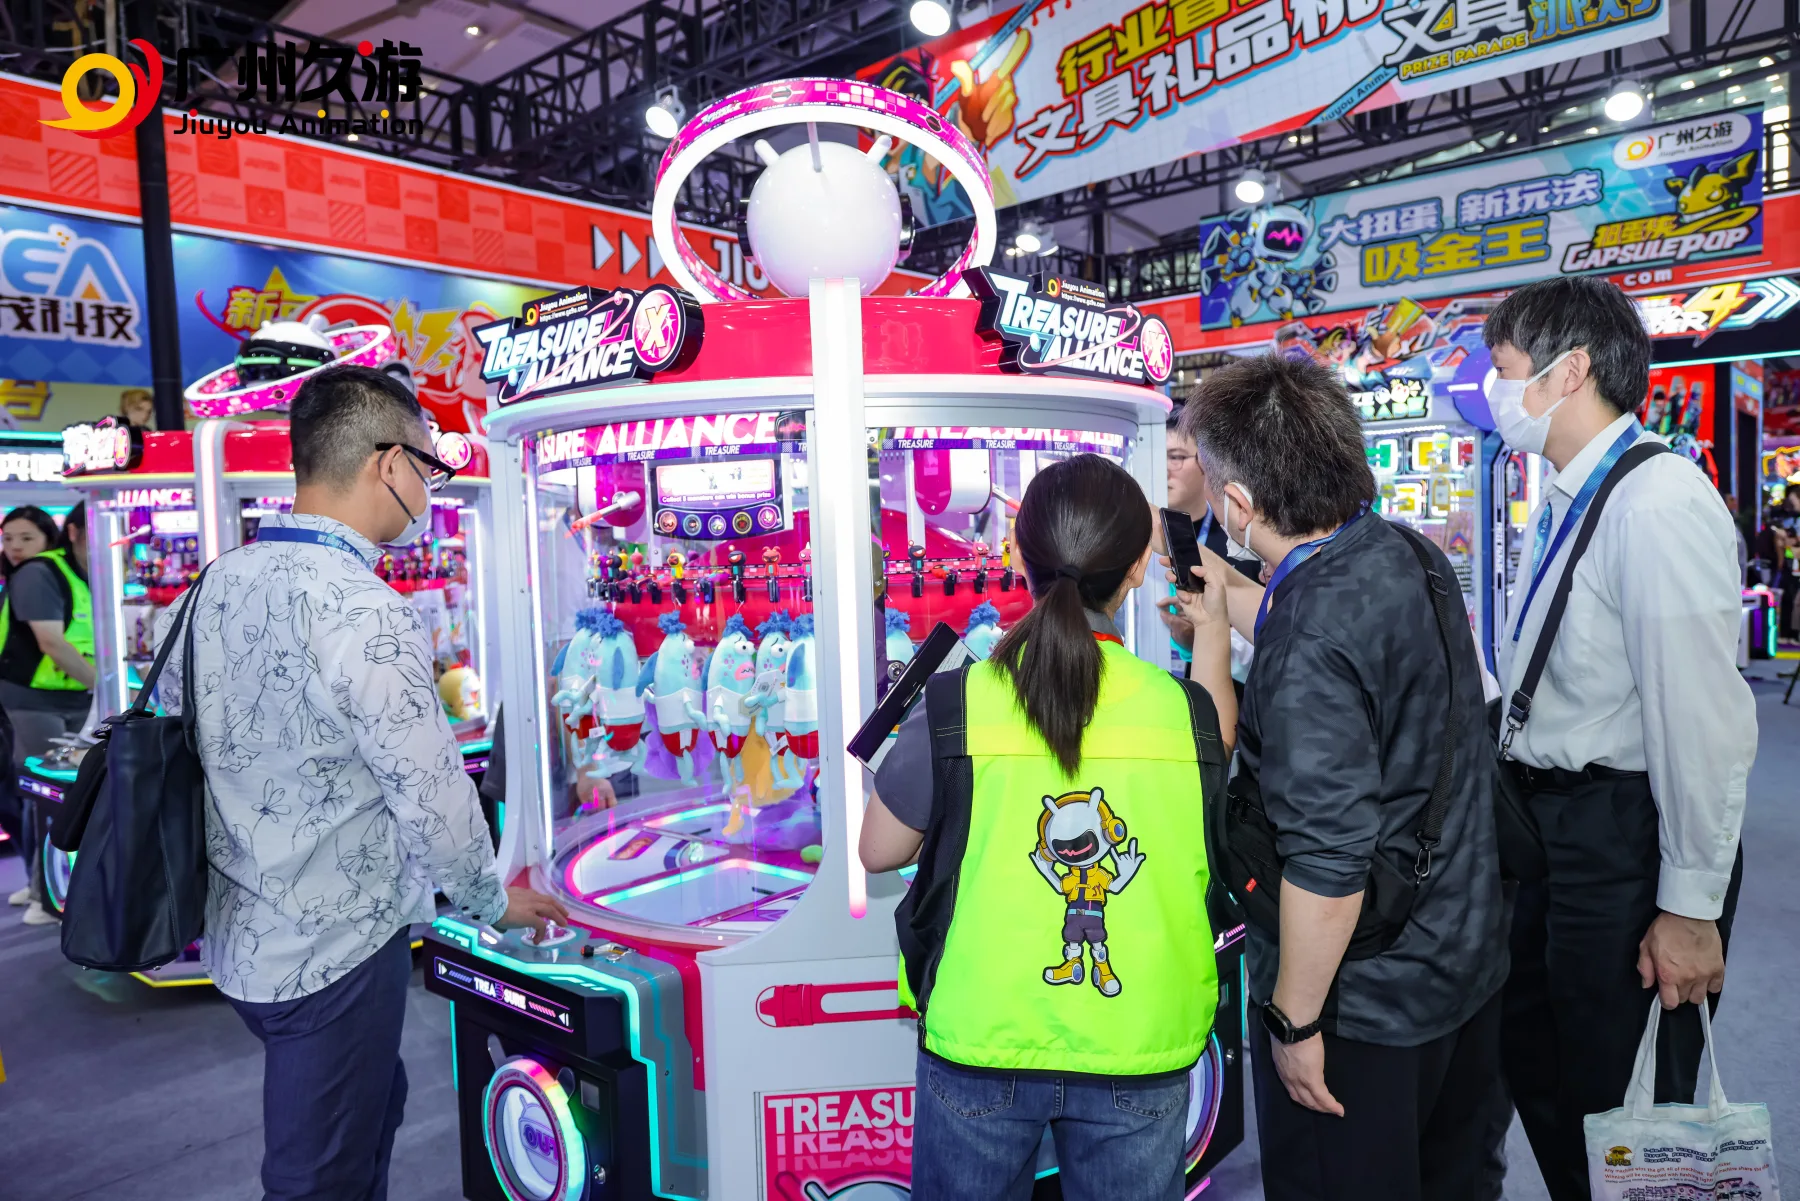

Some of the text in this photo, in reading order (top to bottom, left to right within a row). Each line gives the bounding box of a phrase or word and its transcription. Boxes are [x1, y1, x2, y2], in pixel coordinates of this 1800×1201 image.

[1401, 32, 1527, 78] PRIZE PARADE
[1658, 120, 1733, 149] 广州久游
[1319, 172, 1600, 249] 大扭蛋 新玩法
[1364, 219, 1547, 283] 吸金王
[559, 292, 588, 307] Animation
[988, 272, 1120, 344] TREASURE
[1080, 285, 1105, 298] Animation
[477, 312, 608, 373] TREASURE
[1041, 336, 1144, 380] ALLIANCE
[518, 340, 636, 395] ALLIANCE
[595, 412, 779, 456] ALLIANCE
[705, 445, 740, 455] TREASURE
[898, 439, 934, 449] TREASURE
[985, 440, 1016, 449] TREASURE
[572, 456, 592, 467] TREASURE
[627, 450, 656, 461] TREASURE
